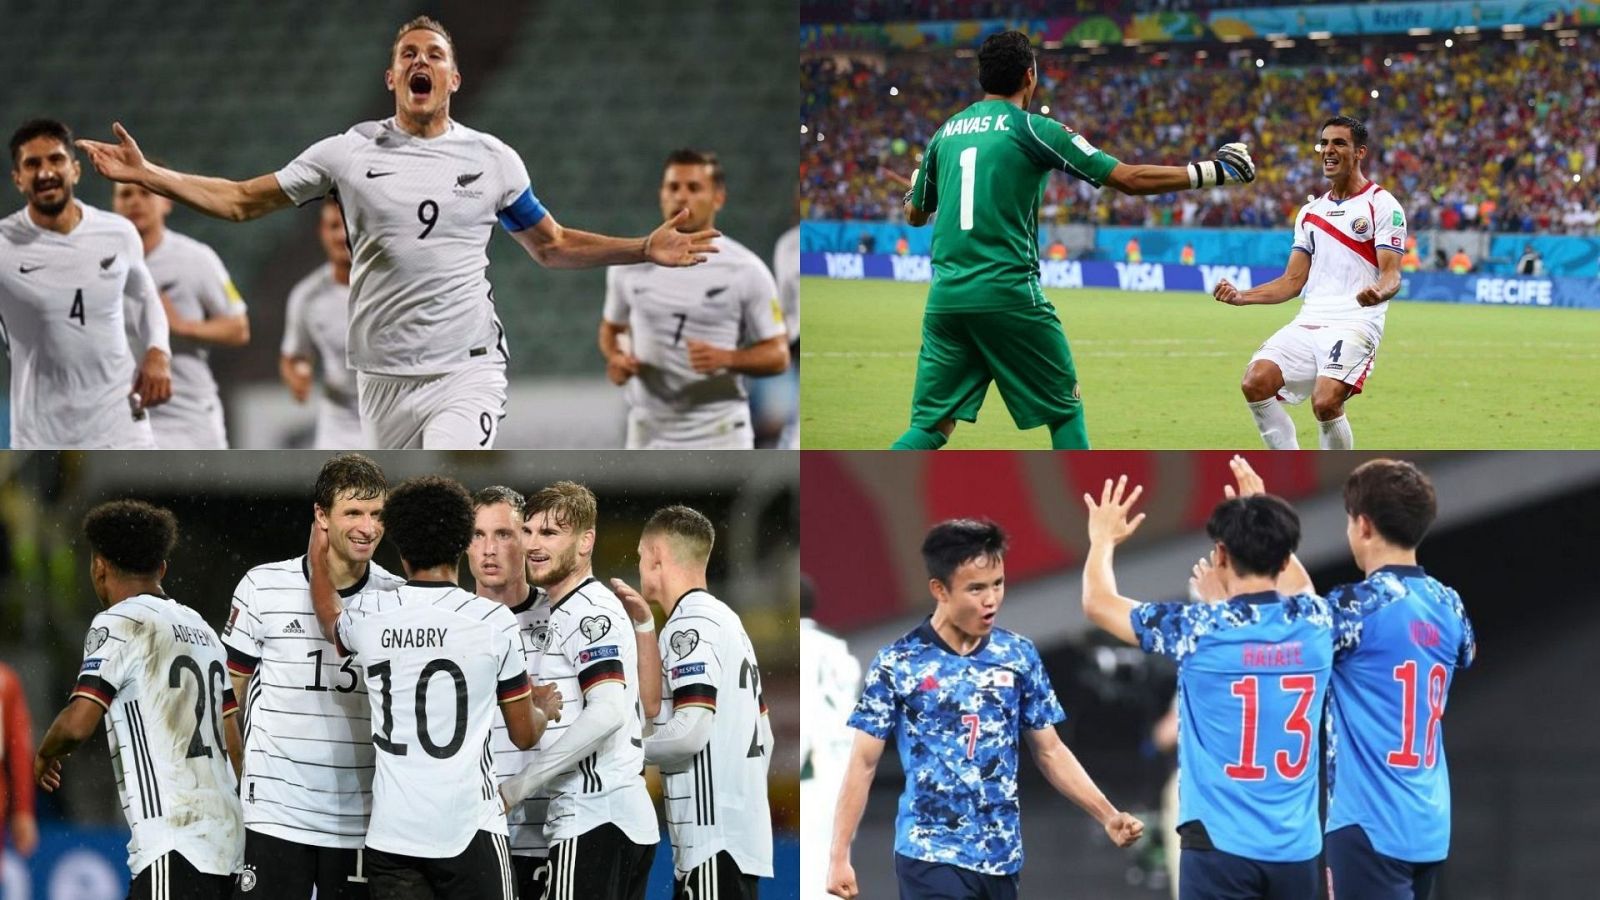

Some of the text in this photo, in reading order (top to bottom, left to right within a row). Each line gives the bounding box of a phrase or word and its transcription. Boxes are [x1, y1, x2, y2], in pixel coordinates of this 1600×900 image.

[942, 114, 1010, 138] NAVAS K.
[960, 146, 977, 230] 1
[417, 200, 439, 240] 9
[825, 252, 865, 279] VISA
[891, 254, 932, 282] VISA
[1114, 262, 1165, 292] VISA
[1199, 265, 1252, 294] VISA
[69, 288, 86, 326] 4
[1476, 278, 1552, 305] RECIFE
[672, 312, 687, 346] 7
[1328, 339, 1344, 363] 4
[479, 411, 493, 447] 9
[381, 628, 448, 648] GNABRY
[589, 646, 618, 659] RESPECT
[678, 664, 705, 674] RESPECT
[1243, 641, 1305, 668] HATATE
[305, 649, 358, 693] 13
[169, 654, 227, 762] 20
[367, 658, 468, 760] 10
[1387, 660, 1447, 769] 18
[961, 713, 979, 760] 7
[1224, 674, 1316, 781] 13
